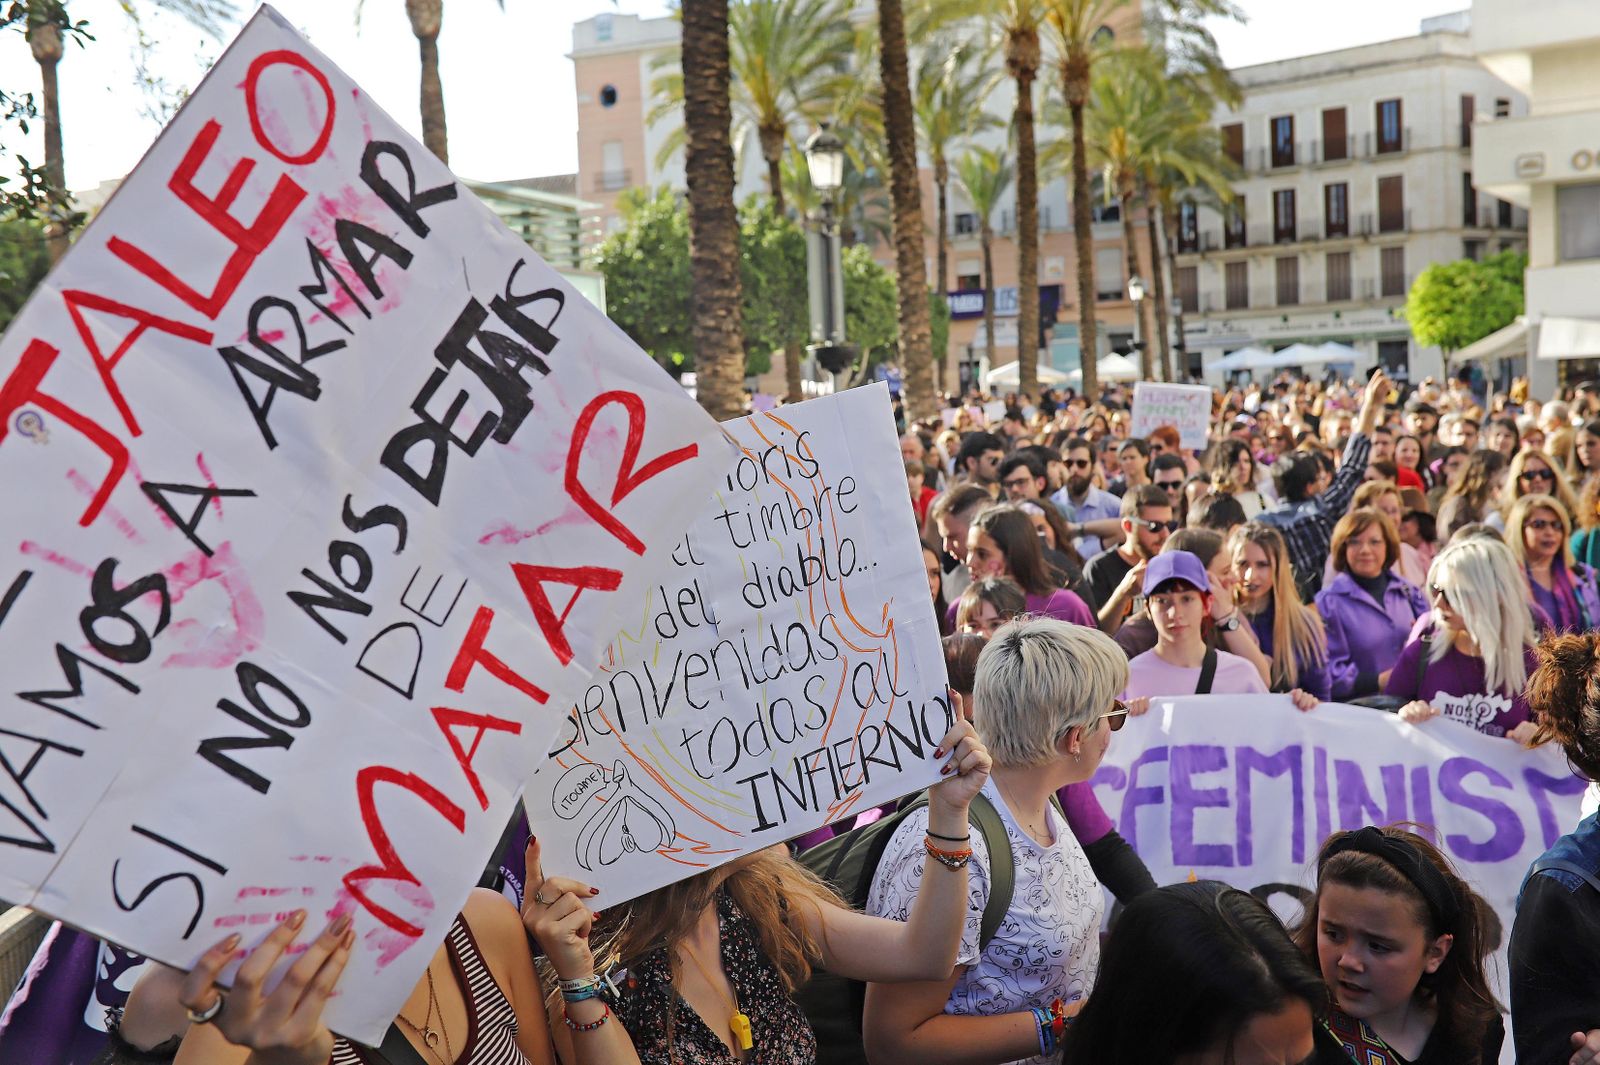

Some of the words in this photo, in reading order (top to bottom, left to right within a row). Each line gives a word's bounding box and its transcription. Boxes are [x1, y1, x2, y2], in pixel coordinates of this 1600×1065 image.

[0, 49, 336, 527] JALEO
[140, 480, 259, 557] A
[217, 140, 458, 450] ARMAR
[714, 474, 859, 550] timbre
[727, 431, 819, 493] oris
[342, 389, 699, 938] MATAR
[356, 565, 468, 700] DE
[655, 577, 721, 639] del
[113, 824, 229, 940] SI
[197, 661, 311, 795] NO
[286, 494, 408, 645] NOS
[680, 674, 828, 780] todas
[851, 652, 909, 710] al
